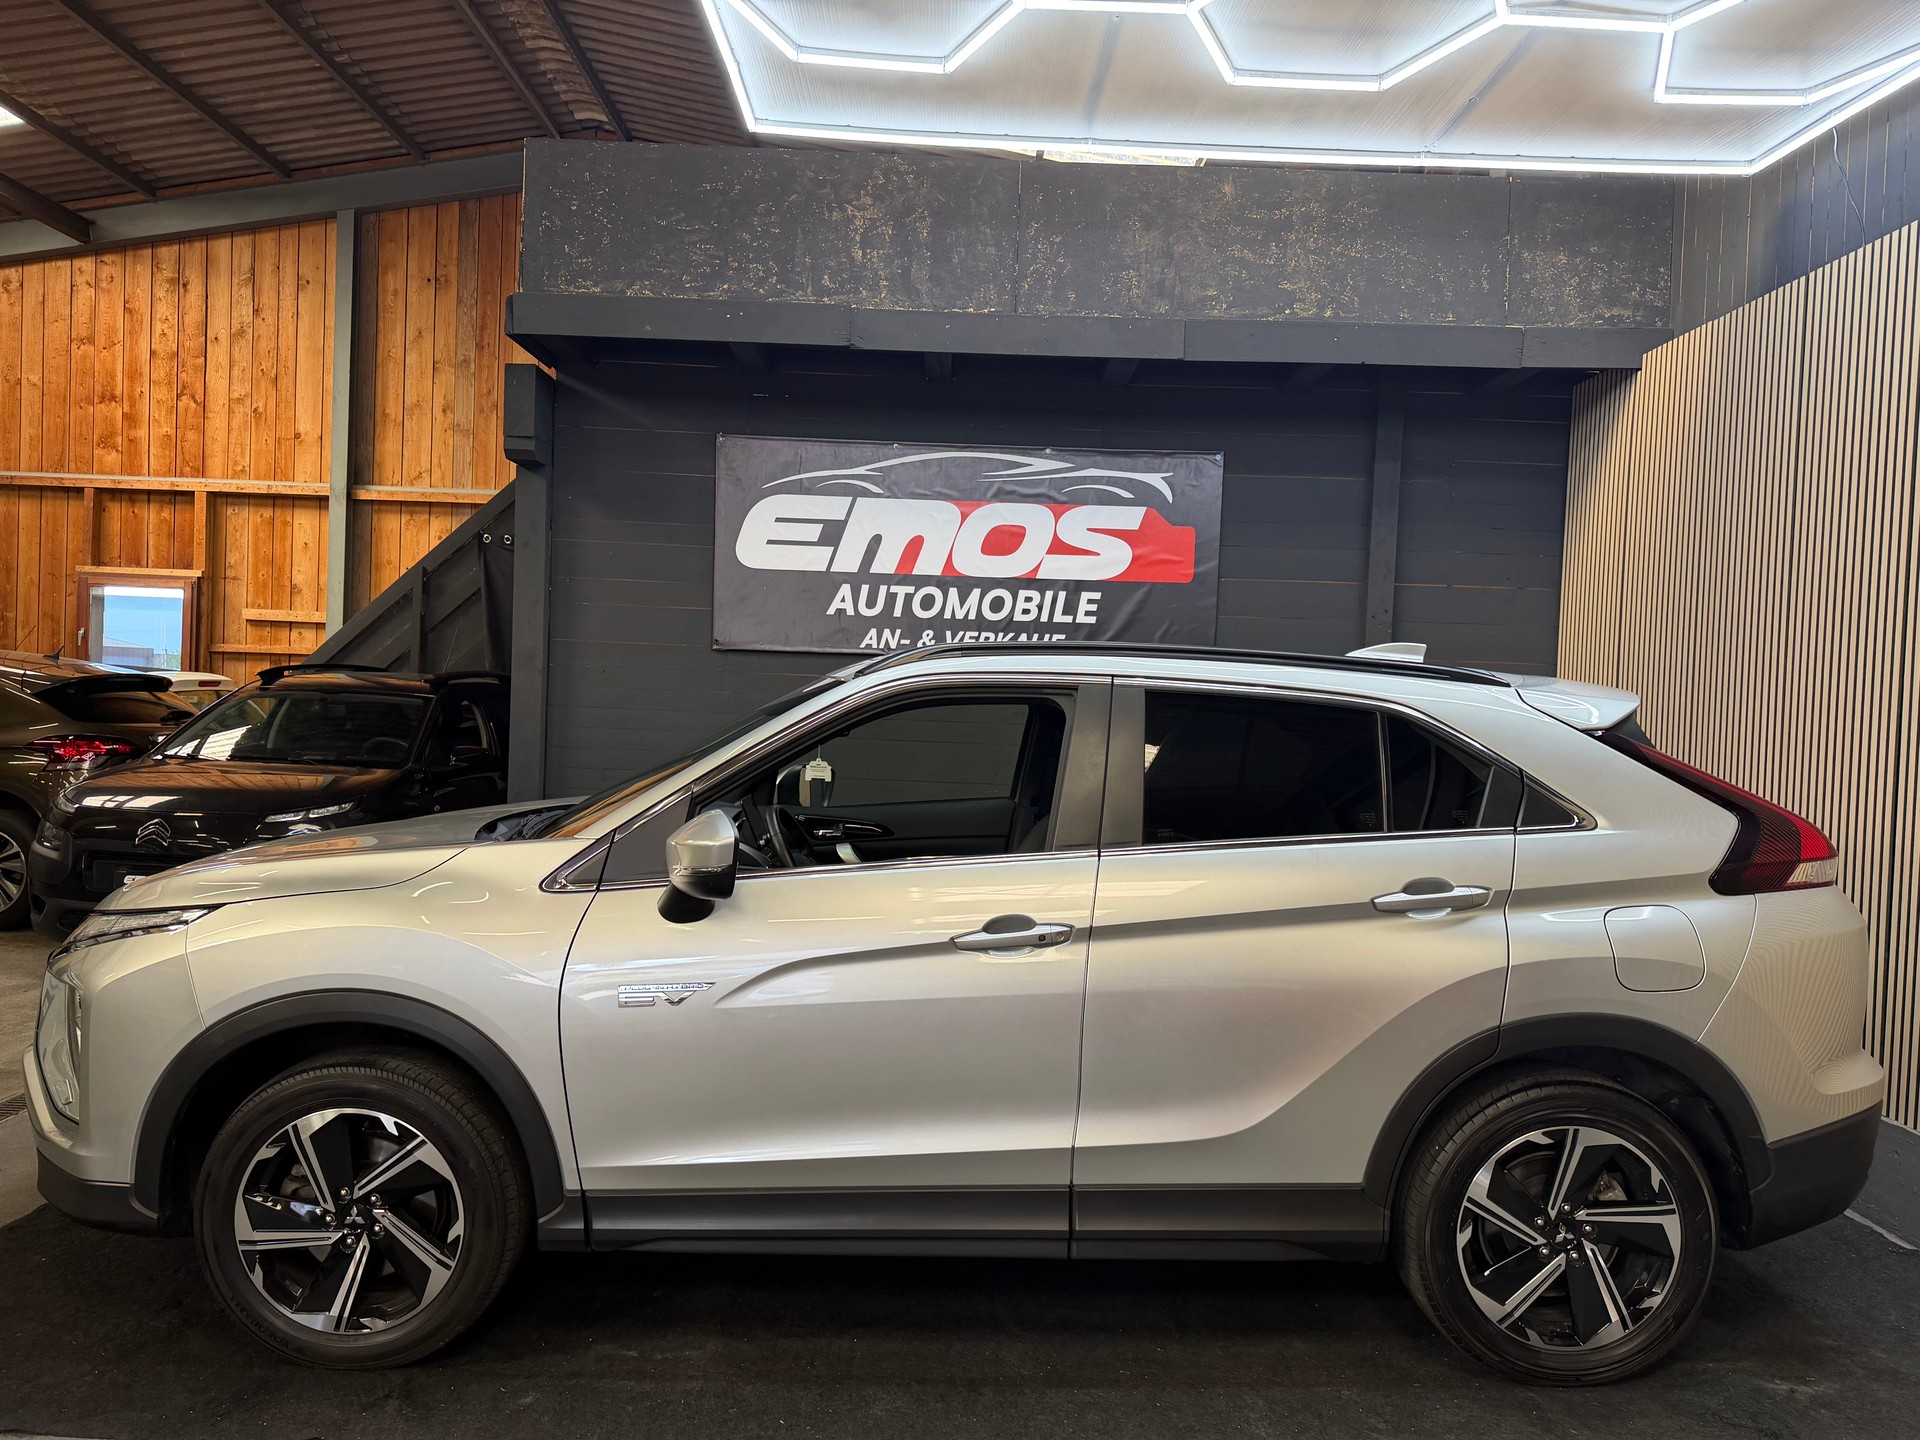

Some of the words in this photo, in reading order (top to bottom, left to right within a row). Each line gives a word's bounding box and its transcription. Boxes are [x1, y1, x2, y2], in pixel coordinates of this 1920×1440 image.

[826, 583, 1102, 624] AUTOMOBILE
[859, 627, 911, 649] AN-
[916, 629, 936, 647] &
[618, 991, 697, 1008] EV
